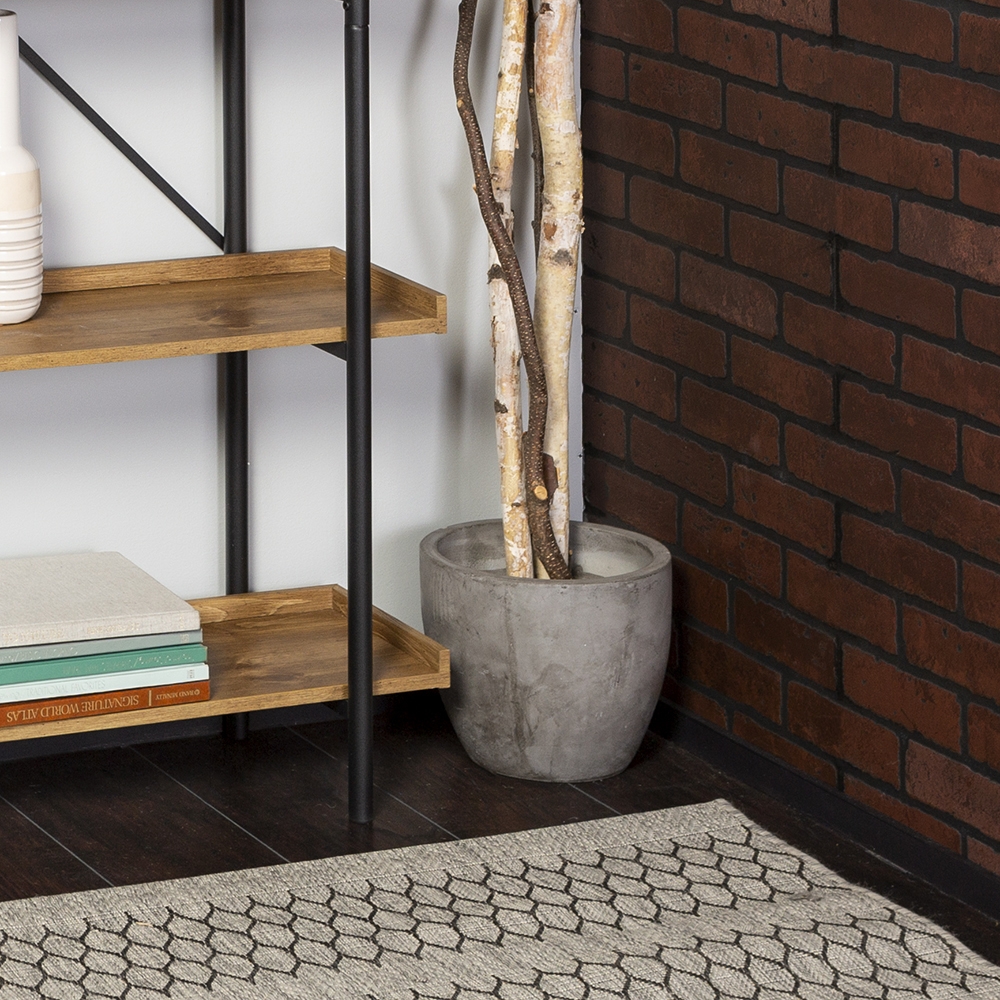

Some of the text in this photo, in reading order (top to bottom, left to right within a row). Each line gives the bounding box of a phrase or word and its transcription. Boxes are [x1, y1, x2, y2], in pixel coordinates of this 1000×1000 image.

[179, 690, 194, 698] RAND
[6, 695, 139, 722] SIGNATURE WORLD ATLAS
